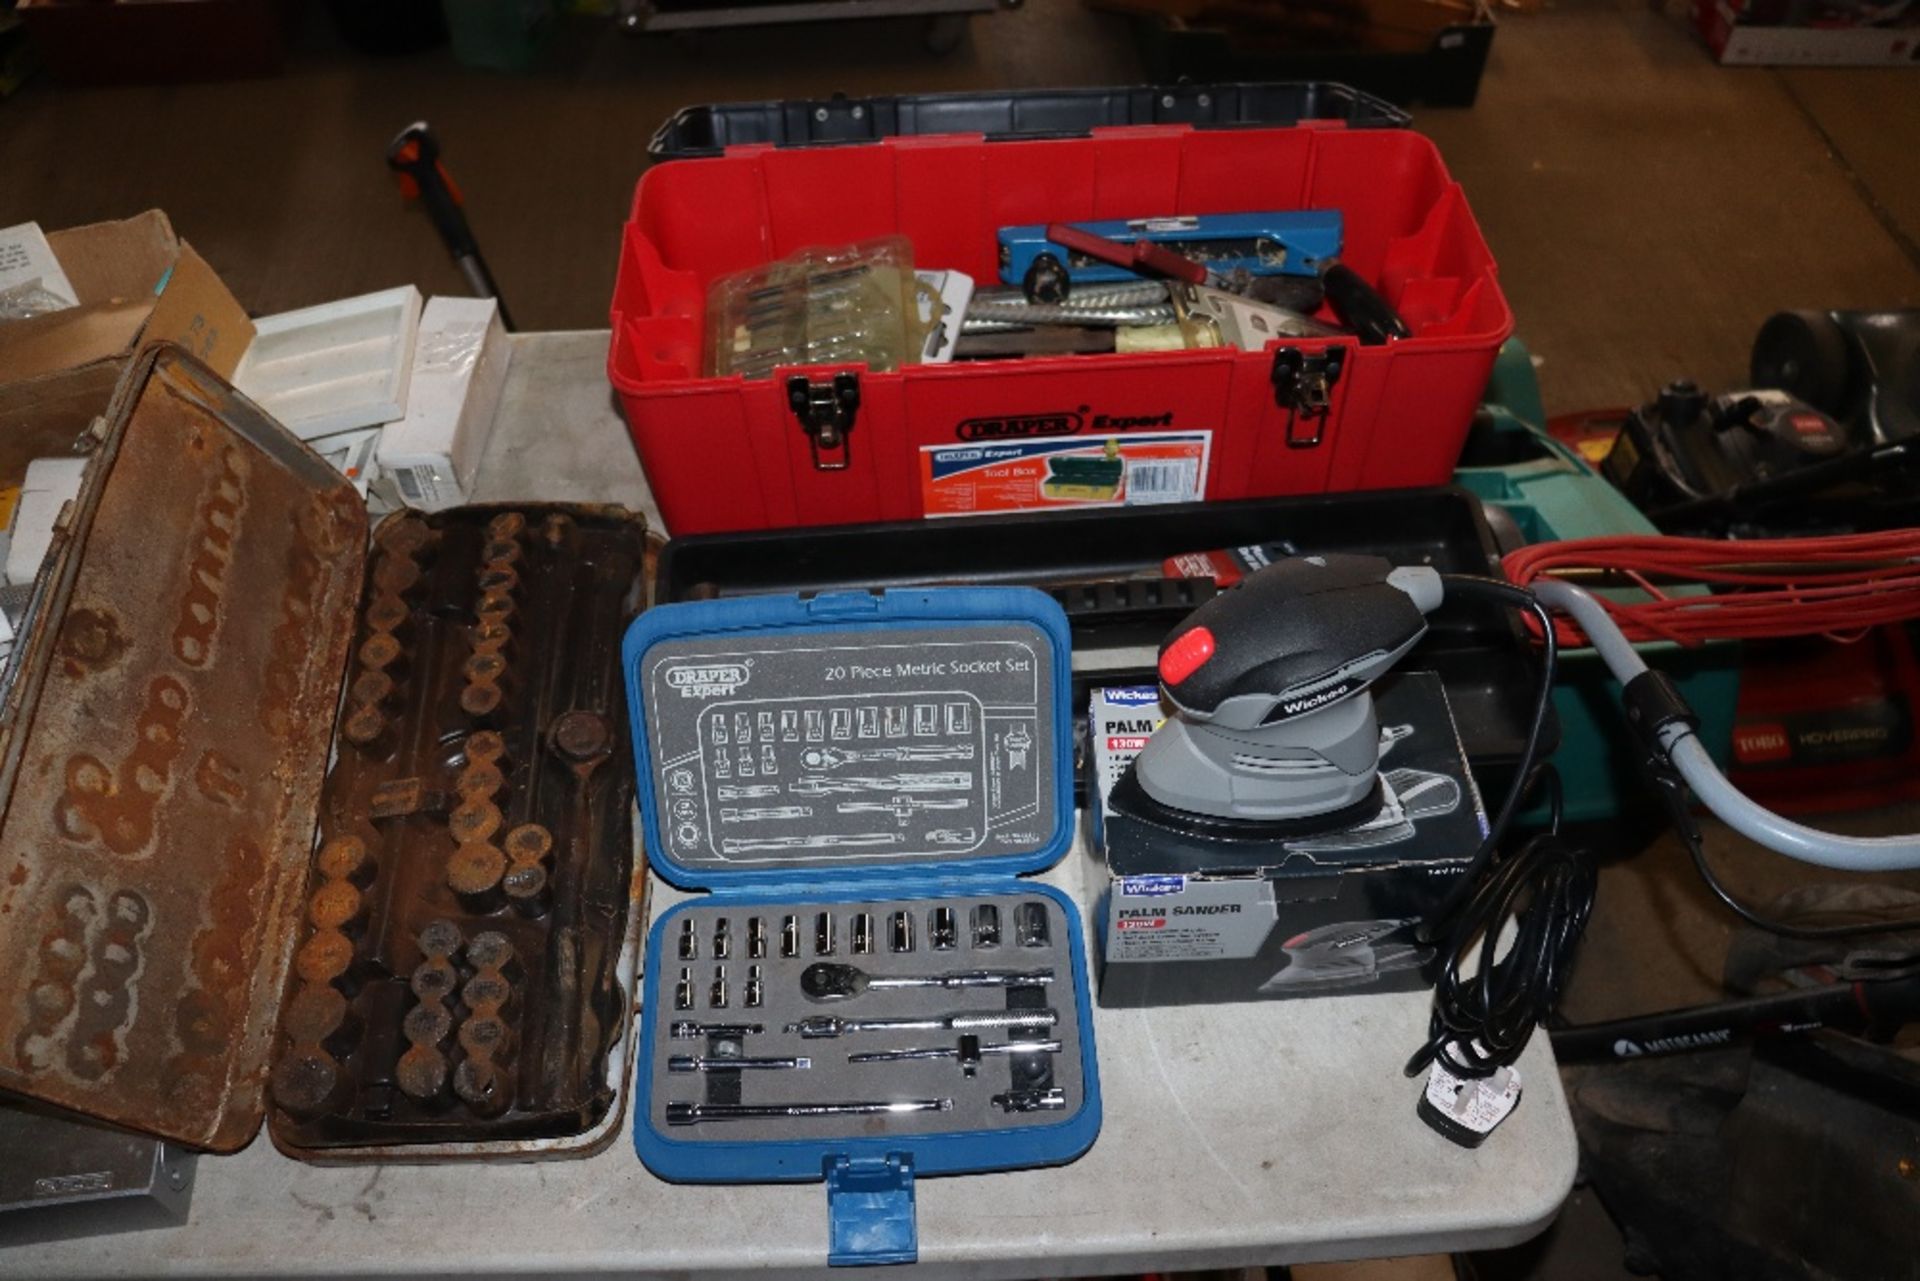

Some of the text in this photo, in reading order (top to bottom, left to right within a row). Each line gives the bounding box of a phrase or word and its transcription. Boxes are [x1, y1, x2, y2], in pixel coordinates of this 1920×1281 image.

[968, 411, 1174, 438] DRAPER Expert
[673, 668, 742, 685] DRAPER
[825, 658, 1030, 681] 20 Piece Metric Socket Set
[680, 685, 736, 700] Expert
[1105, 719, 1153, 734] PALM
[1118, 903, 1242, 919] PALM SANDER
